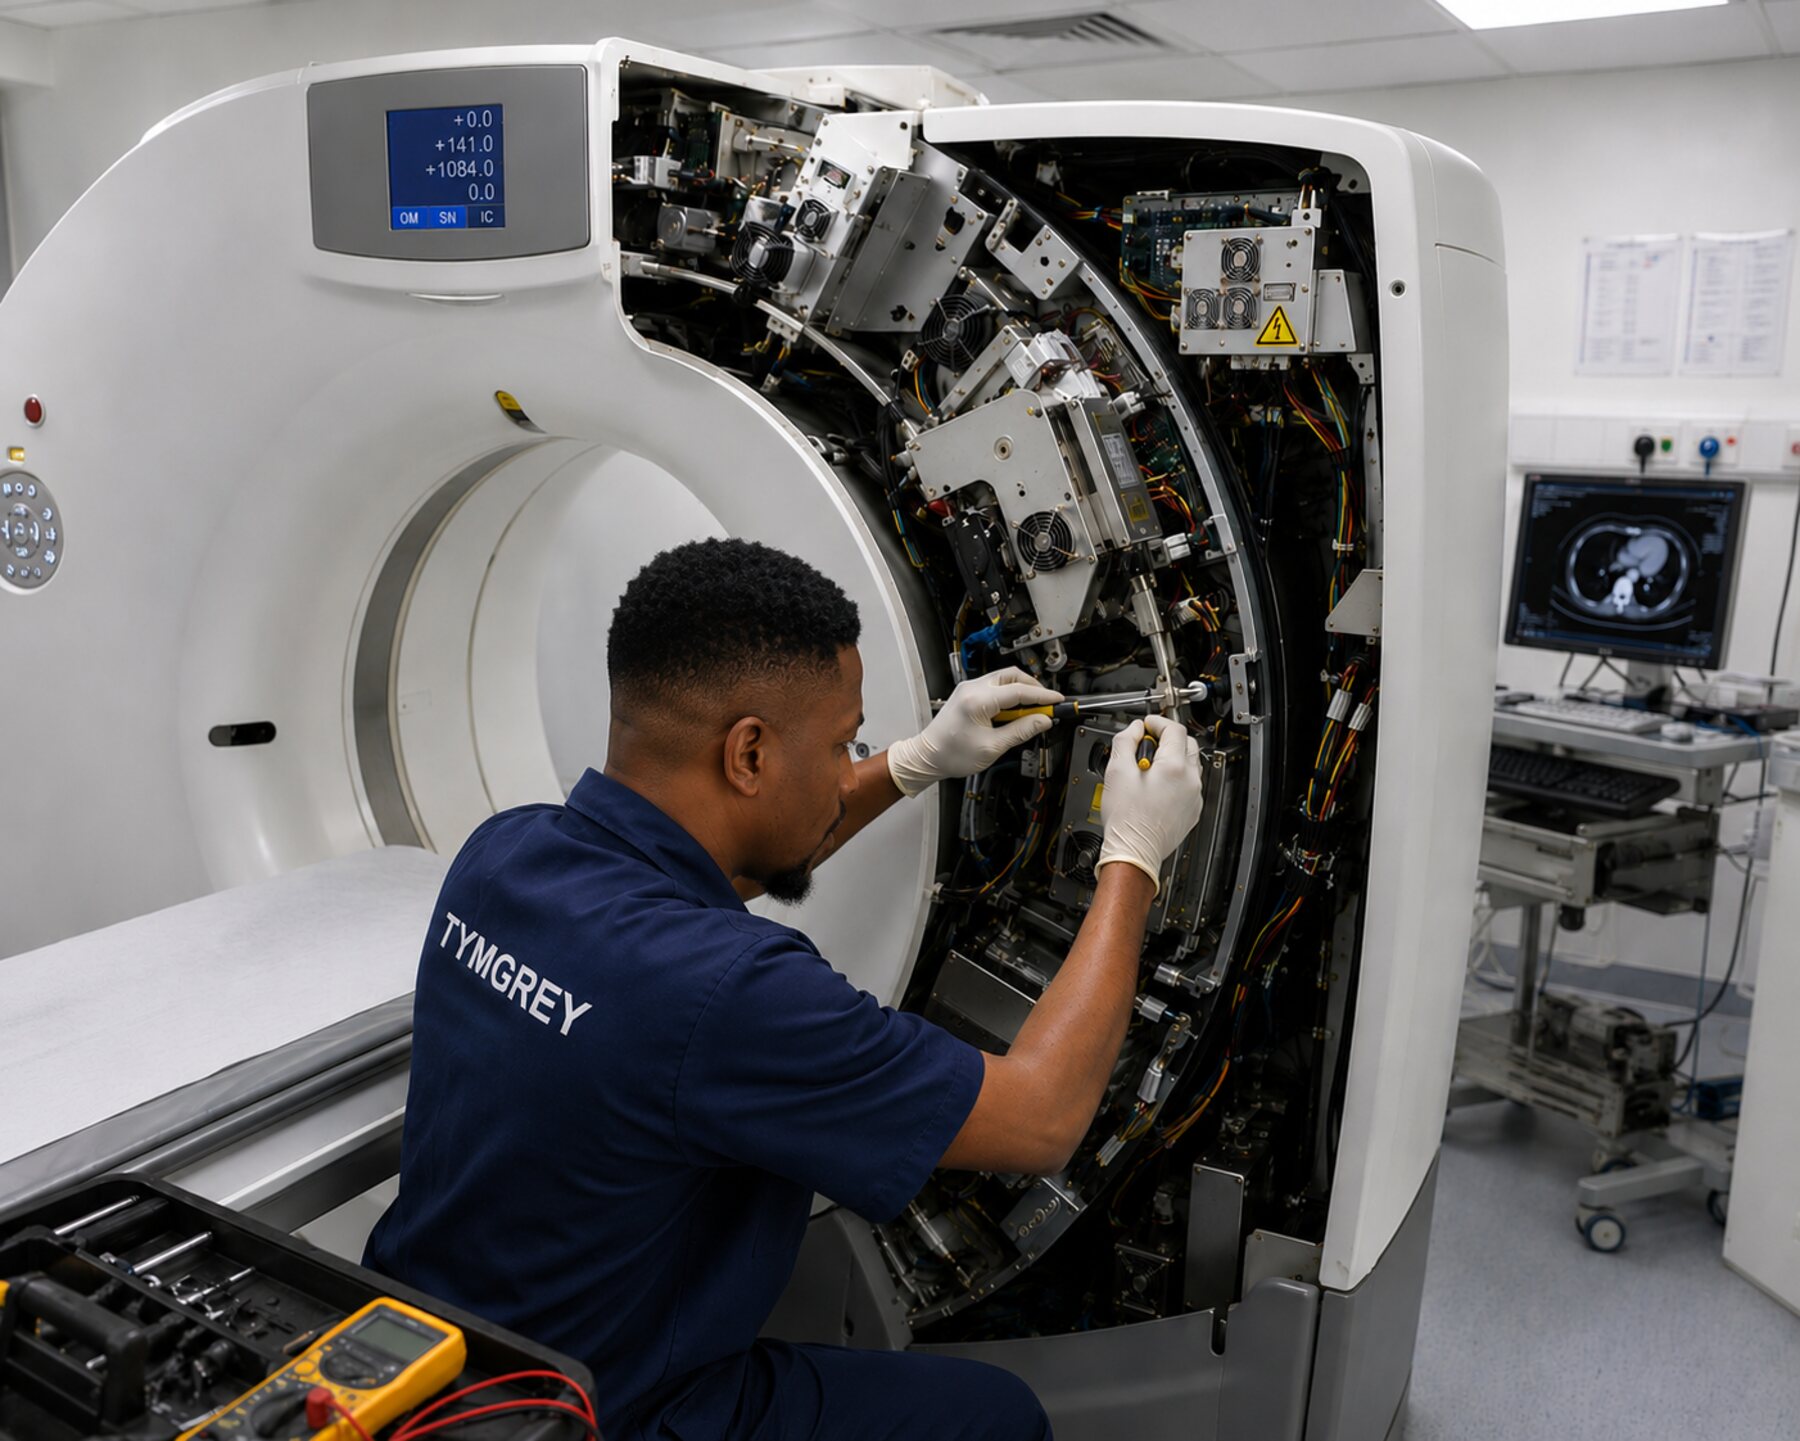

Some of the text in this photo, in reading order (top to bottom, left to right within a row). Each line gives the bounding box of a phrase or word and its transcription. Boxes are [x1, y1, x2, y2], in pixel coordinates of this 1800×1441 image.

[454, 110, 493, 128] +0.0
[435, 134, 493, 153] +141.0
[425, 159, 494, 178] +1084.0
[468, 183, 495, 201] 0.0
[399, 210, 494, 225] OM SN IC
[440, 911, 593, 1036] TYMGREY
